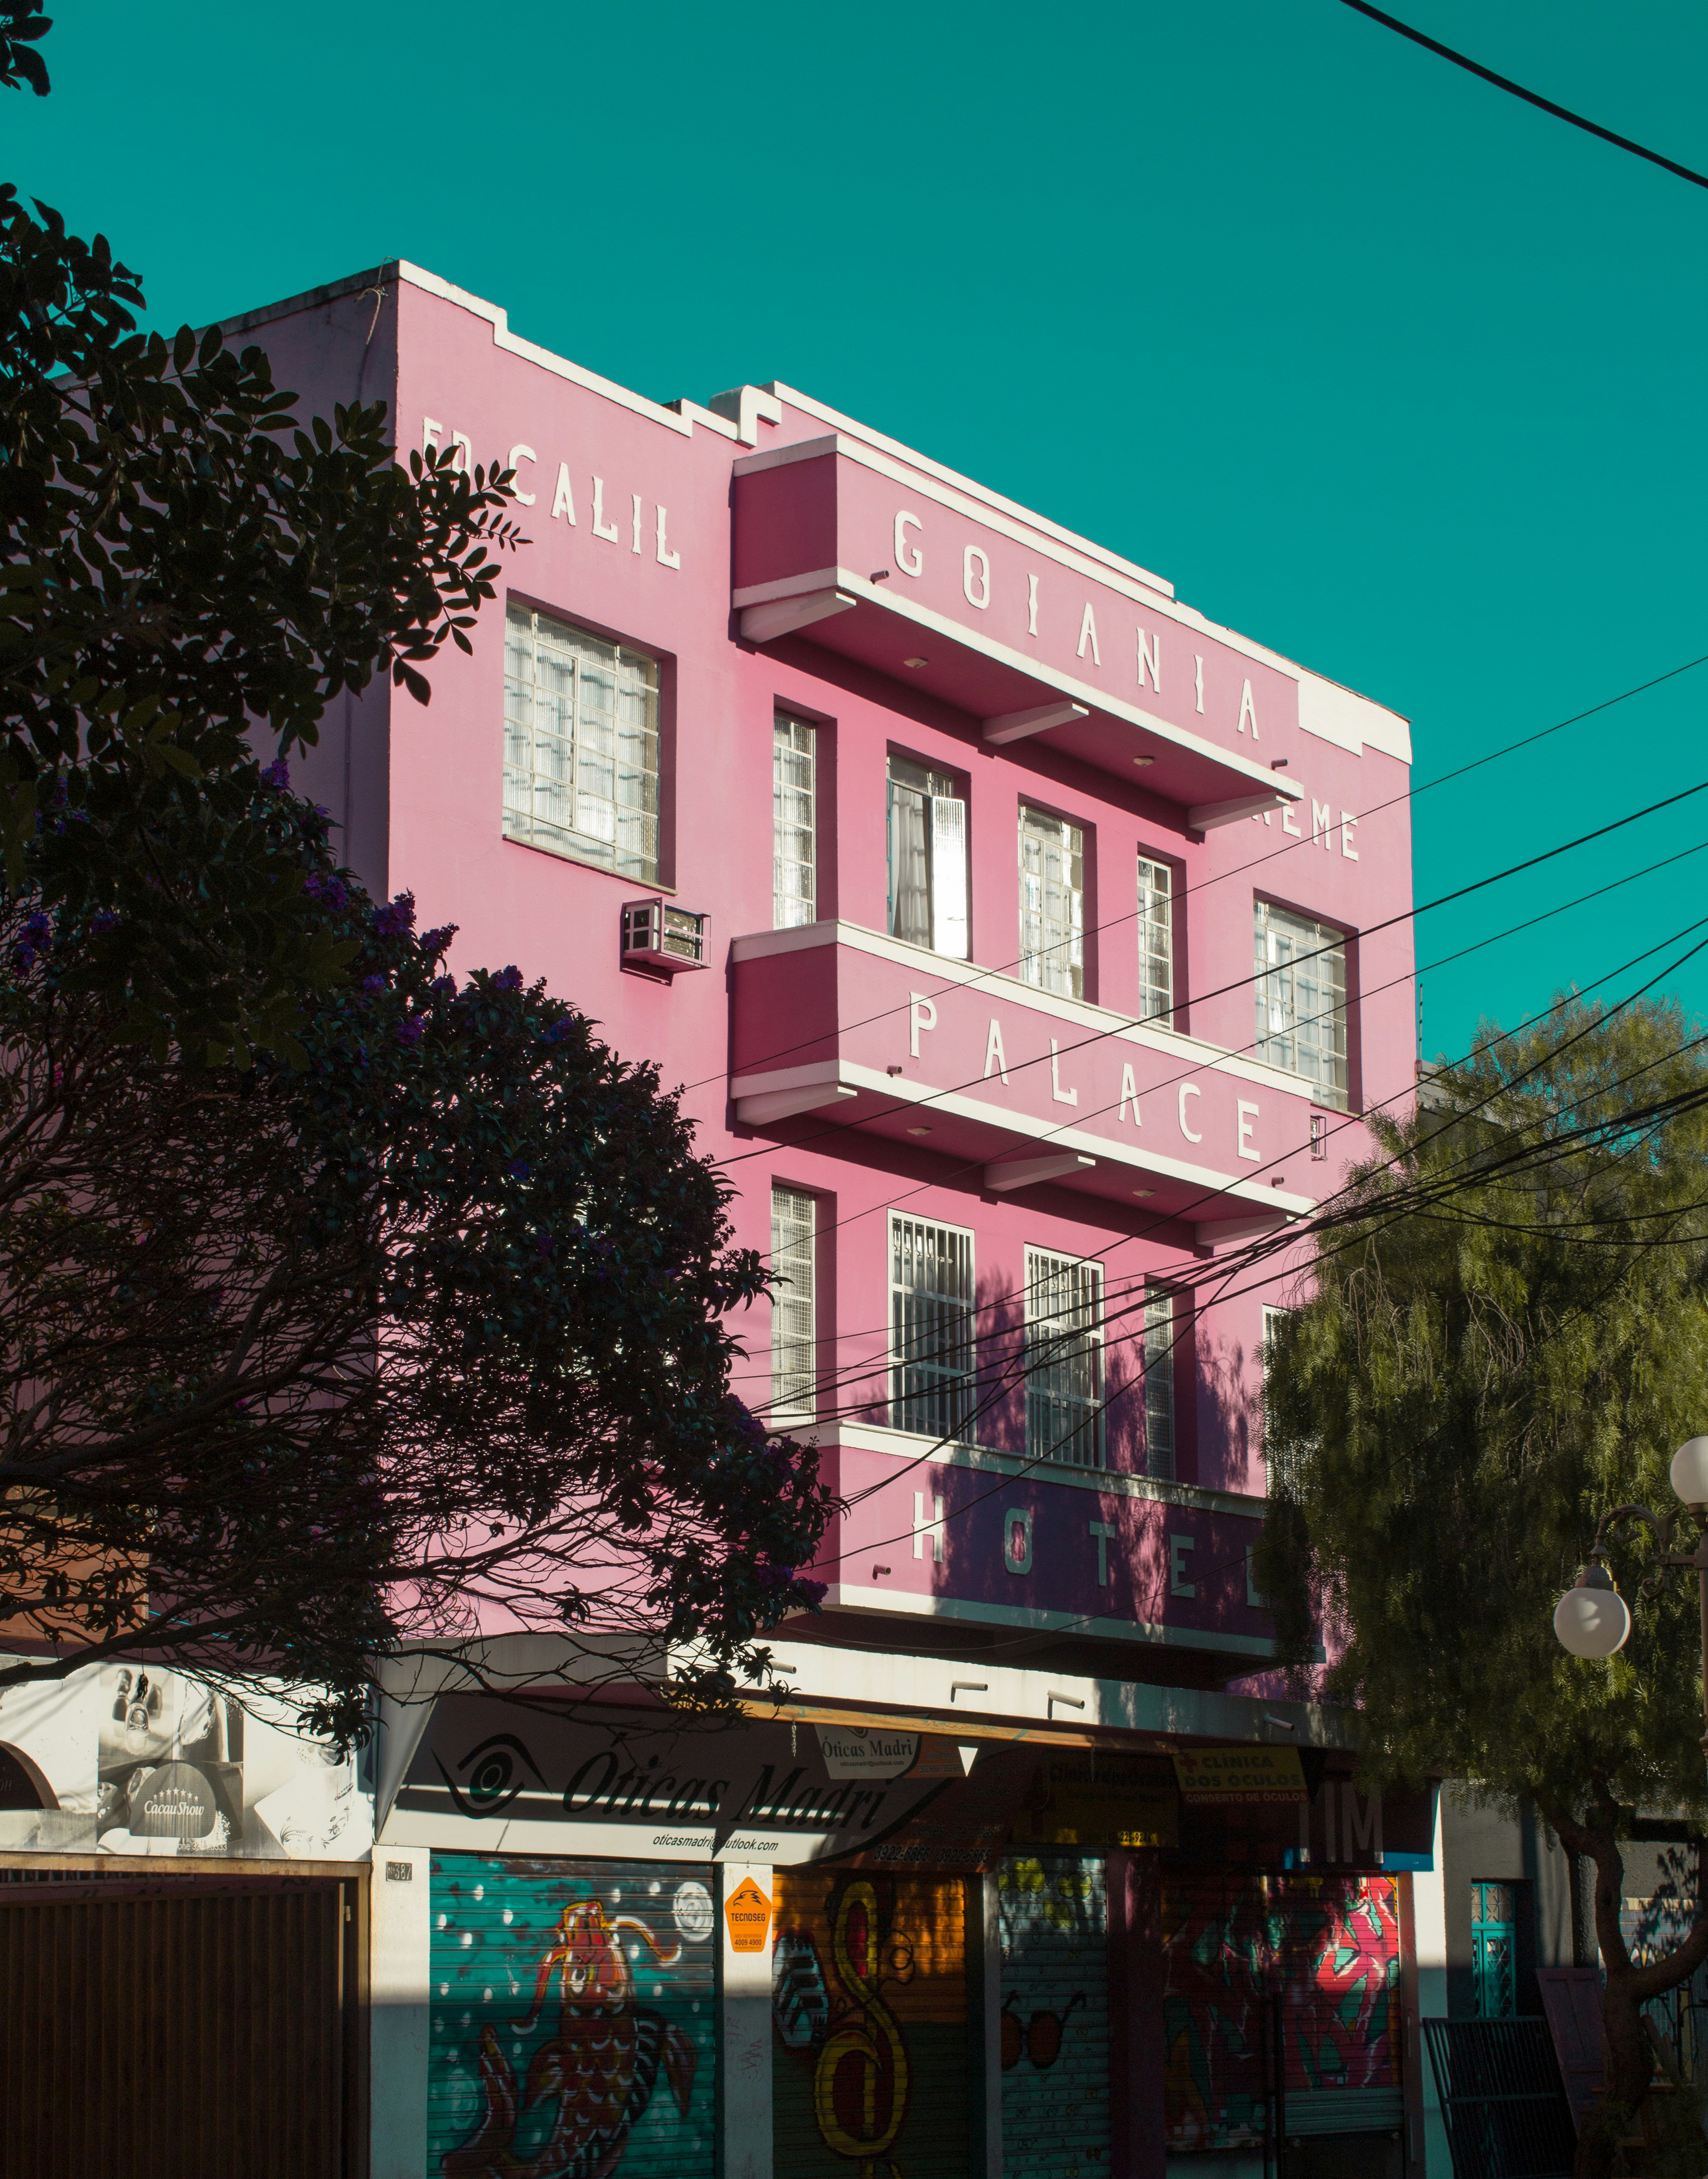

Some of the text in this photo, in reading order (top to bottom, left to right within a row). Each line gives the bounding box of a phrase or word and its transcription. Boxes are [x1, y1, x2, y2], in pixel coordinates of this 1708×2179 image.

[508, 444, 680, 570] CALIL
[893, 510, 1259, 741] GOIANIA
[909, 991, 1261, 1163] PALACE
[912, 1491, 1269, 1608] HOTEL
[822, 1736, 865, 1758] Óticas
[868, 1739, 912, 1757] Madri
[1202, 1753, 1274, 1768] CLÍNICA
[1185, 1771, 1301, 1787] DOS ÓCULOS
[729, 1765, 893, 1830] Madri
[1185, 1792, 1242, 1802] CONSERTO
[1245, 1793, 1260, 1802] DE
[653, 1834, 779, 1851] oticasmadri@outlook.com
[395, 1863, 411, 1880] 387
[731, 1913, 766, 1921] TECNOSEG
